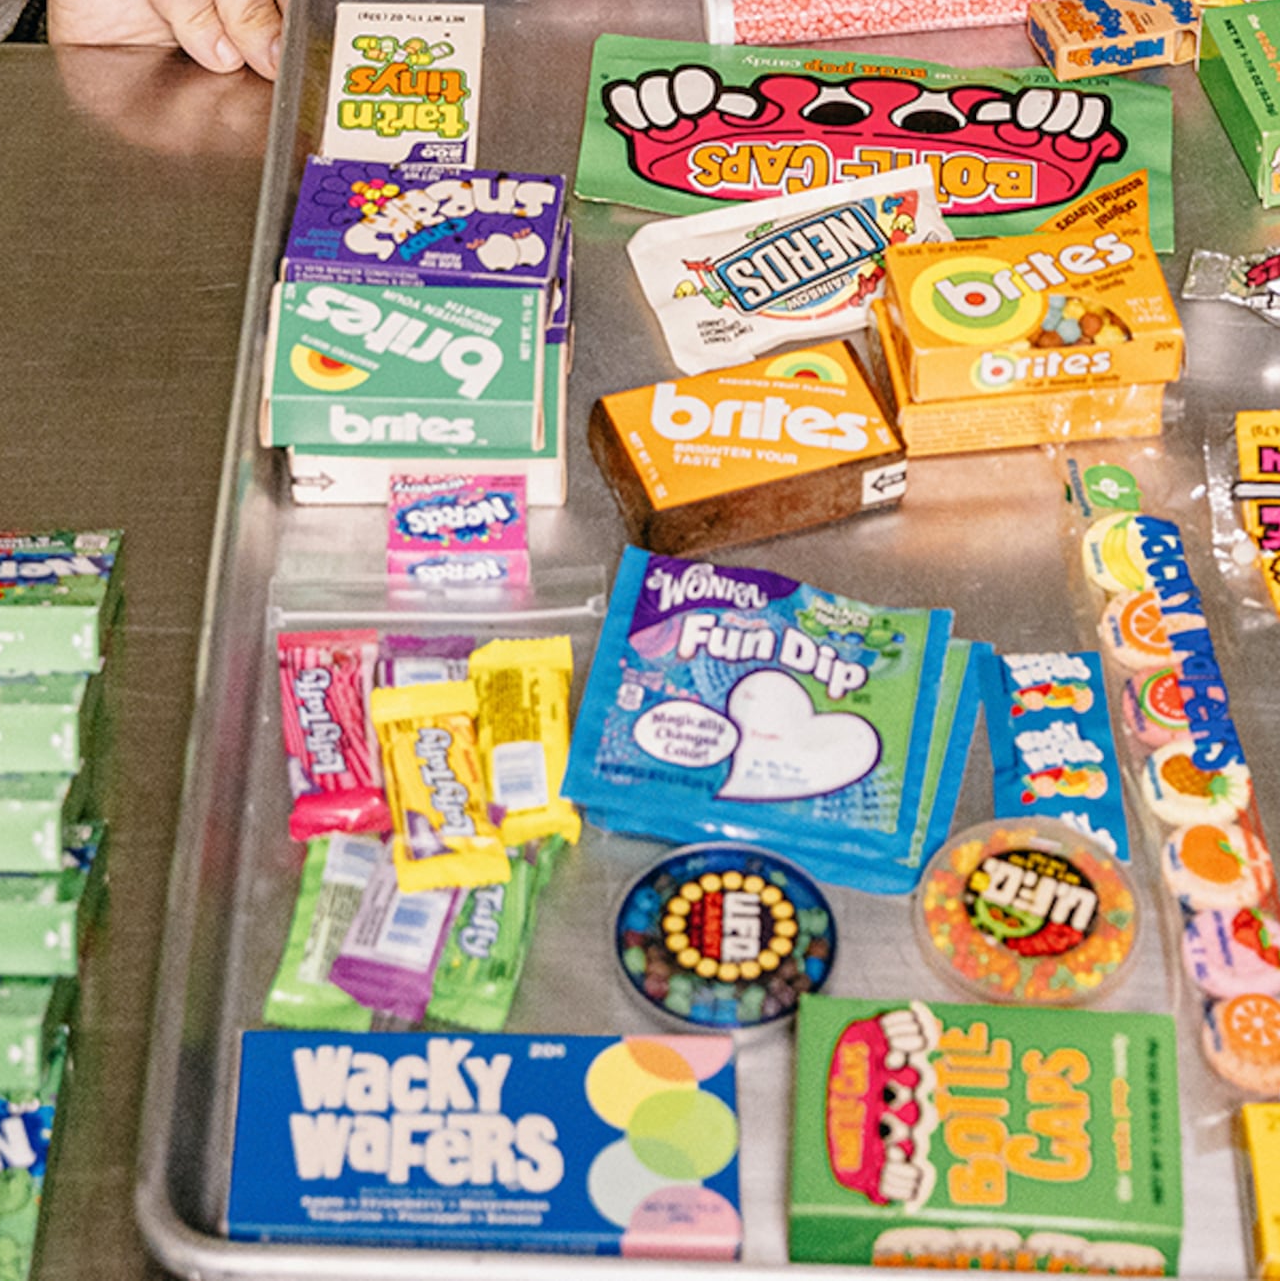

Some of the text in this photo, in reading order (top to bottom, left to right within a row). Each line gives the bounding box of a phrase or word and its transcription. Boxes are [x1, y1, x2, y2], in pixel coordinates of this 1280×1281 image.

[343, 63, 471, 105] tinys
[687, 141, 833, 196] CAPS
[1055, 177, 1145, 232] assorted flavors
[1093, 198, 1138, 231] original
[726, 207, 878, 305] NERDS
[933, 233, 1134, 318] brites
[294, 285, 504, 400] brites
[977, 351, 1112, 388] brites
[328, 404, 476, 446] brites
[650, 381, 869, 452] brites
[677, 613, 776, 663] Fun
[778, 624, 870, 701] Dip
[651, 711, 726, 737] Magically
[655, 728, 719, 749] Changes
[457, 884, 506, 959] Taffy
[933, 1020, 1012, 1206] BOTTLE
[1003, 1047, 1093, 1183] CAPS
